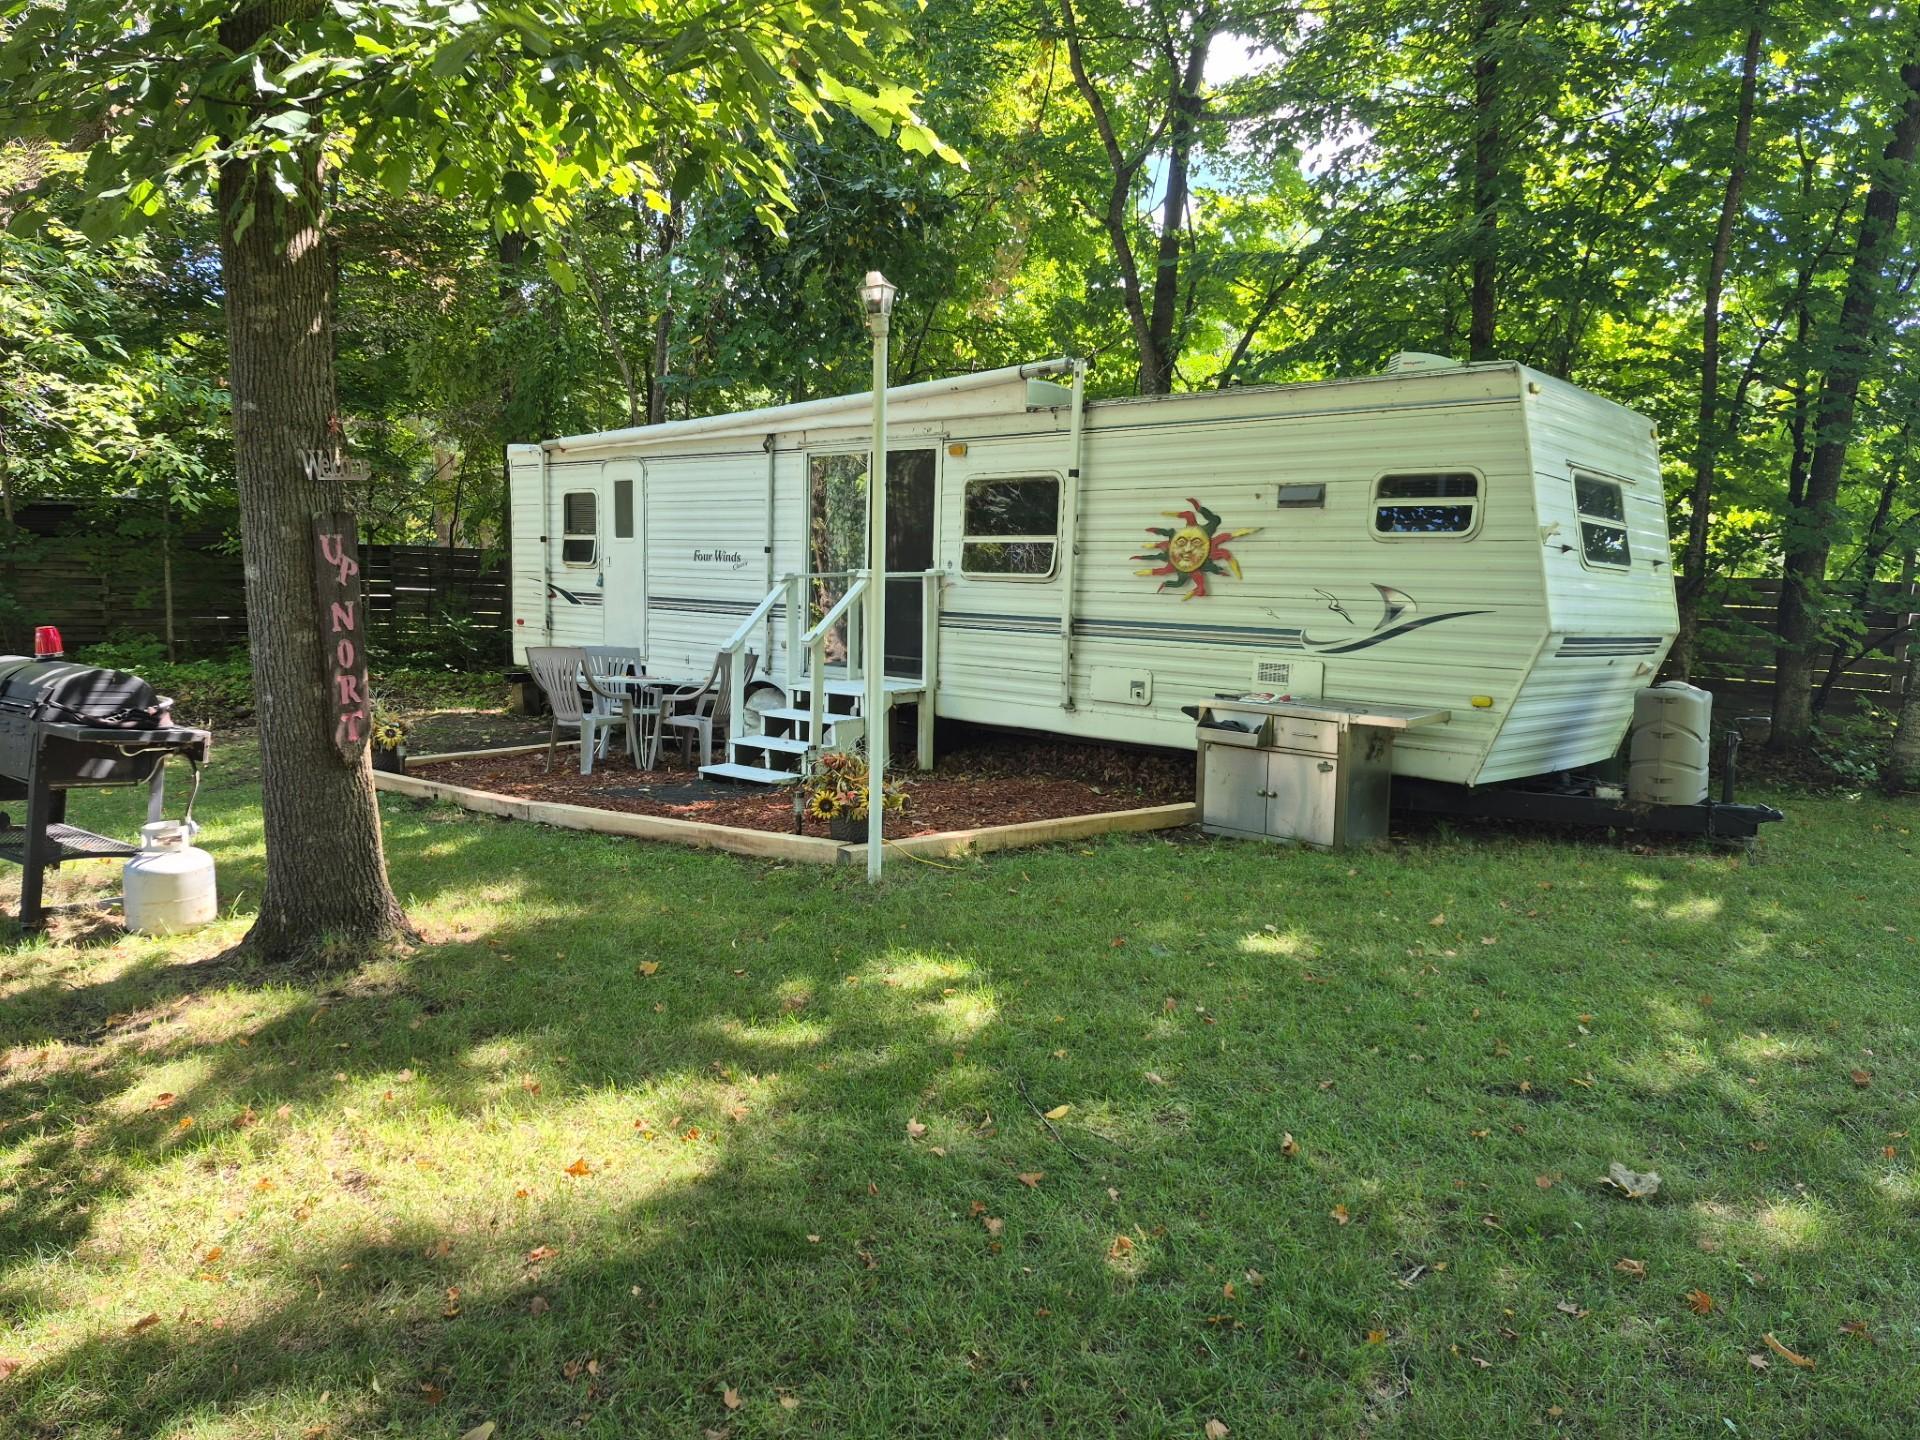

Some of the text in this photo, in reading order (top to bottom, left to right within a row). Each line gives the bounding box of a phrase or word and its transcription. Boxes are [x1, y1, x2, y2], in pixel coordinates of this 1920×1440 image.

[297, 448, 372, 481] Welcome
[693, 549, 742, 563] Four Winds
[319, 534, 364, 741] UP NORT
